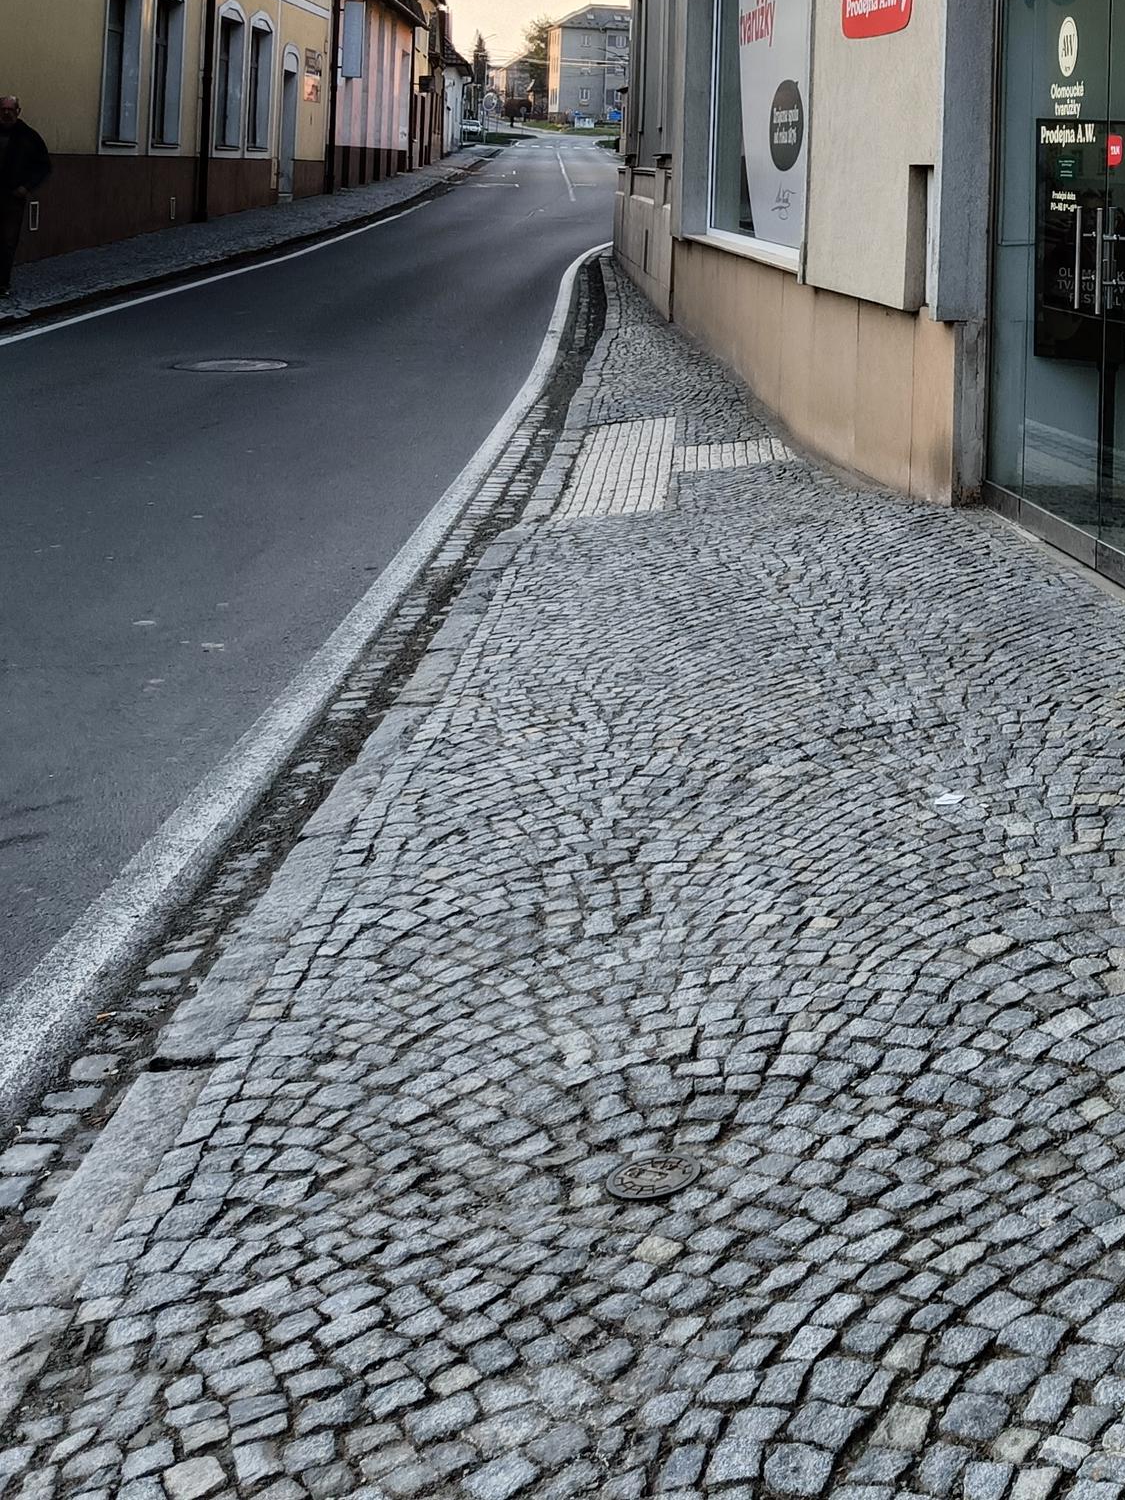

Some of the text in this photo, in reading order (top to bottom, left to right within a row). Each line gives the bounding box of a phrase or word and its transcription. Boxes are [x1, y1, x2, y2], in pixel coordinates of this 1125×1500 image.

[1050, 80, 1085, 100] Olomoucké
[1054, 98, 1081, 118] tvarůžky
[1040, 123, 1096, 148] Prodejna A.W.
